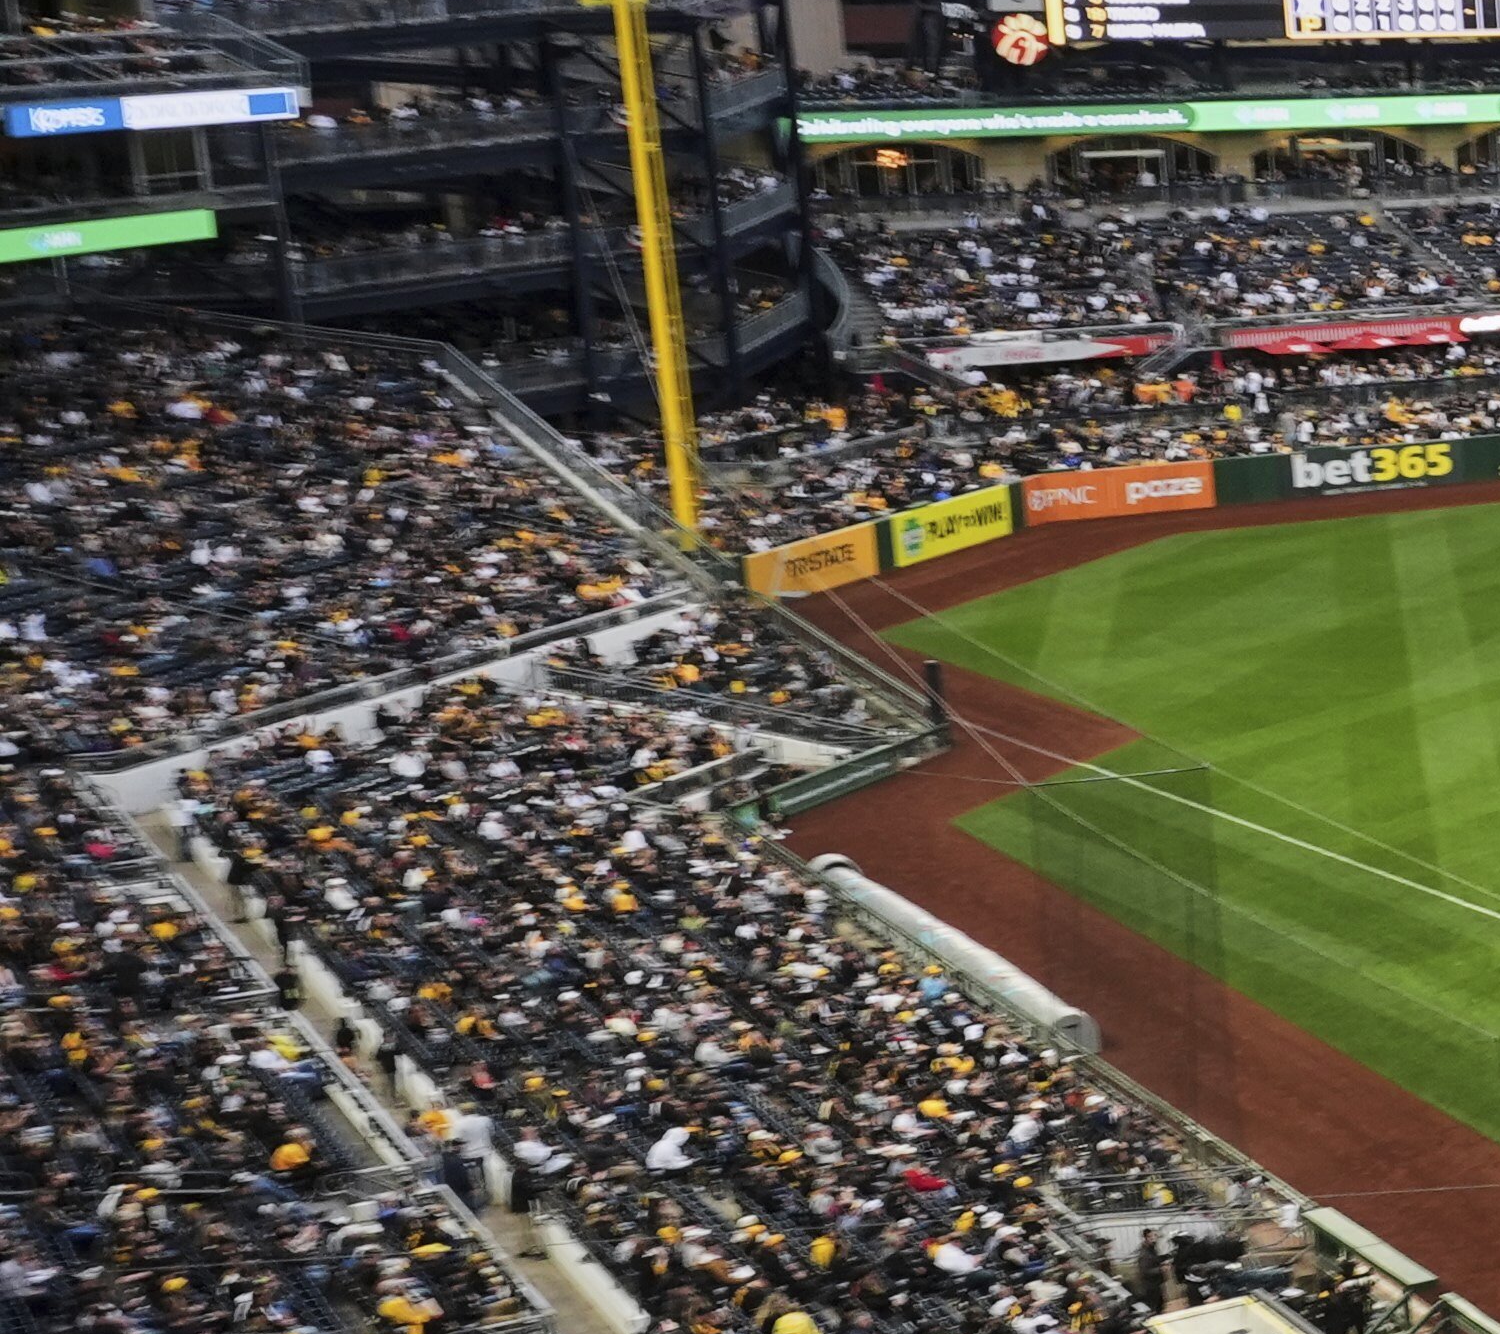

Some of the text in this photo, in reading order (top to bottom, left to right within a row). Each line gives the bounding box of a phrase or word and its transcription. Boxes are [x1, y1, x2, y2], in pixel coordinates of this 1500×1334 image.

[1292, 442, 1453, 489] bet365
[1042, 484, 1098, 506] PNC
[1124, 476, 1203, 505] paze
